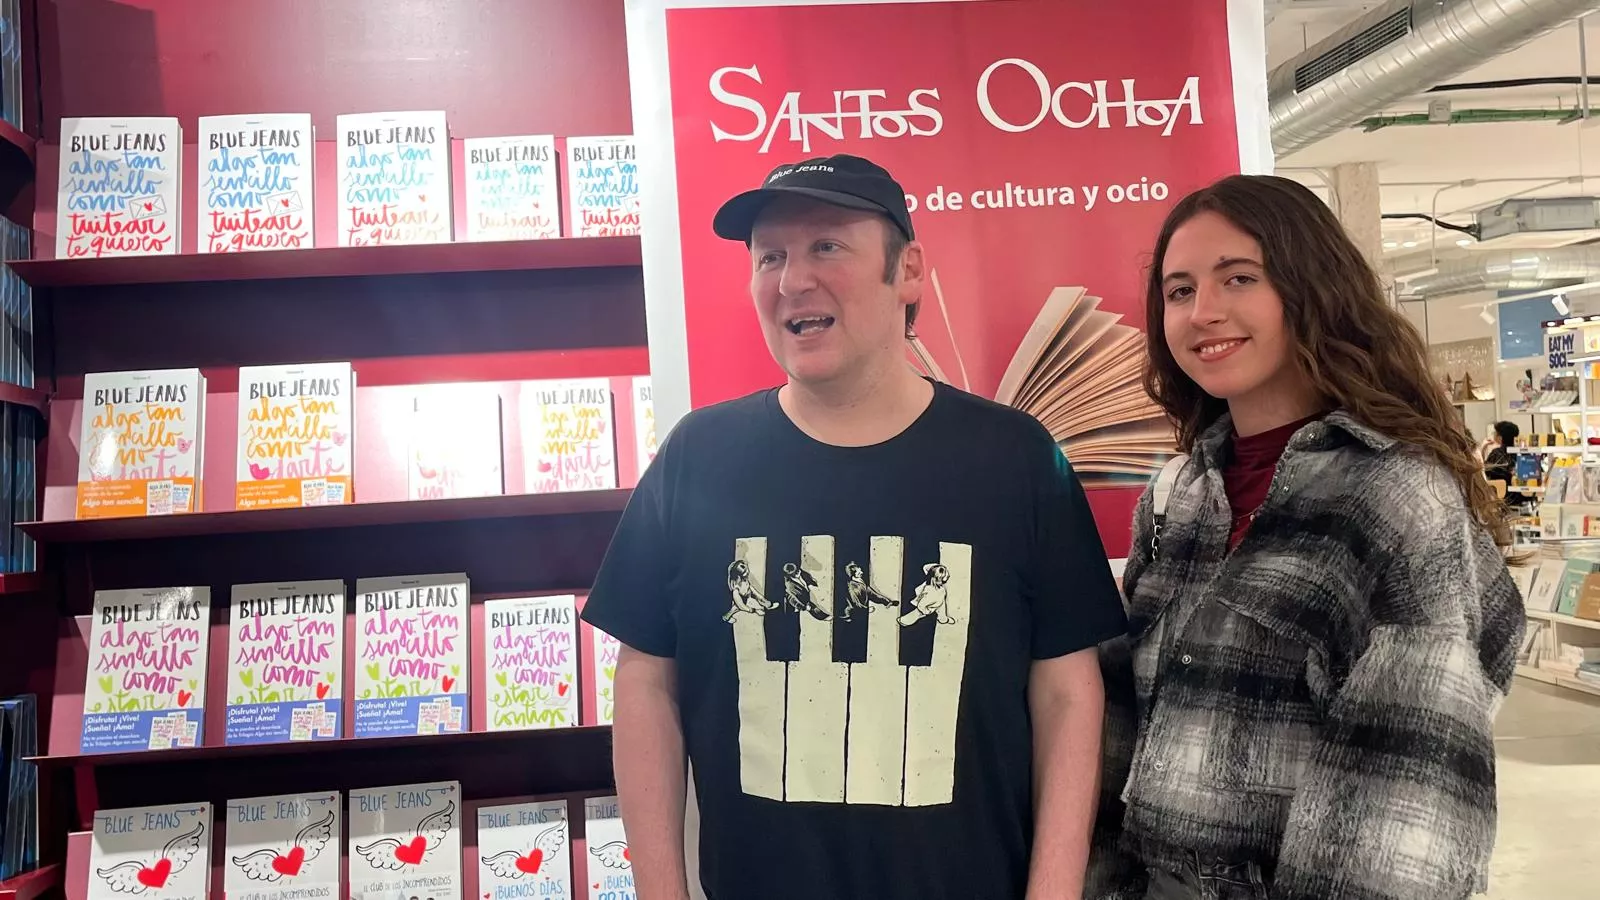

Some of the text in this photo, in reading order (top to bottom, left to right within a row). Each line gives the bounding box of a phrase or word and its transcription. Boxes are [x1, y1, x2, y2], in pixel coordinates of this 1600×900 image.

[71, 133, 167, 152] BLUE JEANS
[210, 130, 301, 150] BLUE JEANS
[348, 126, 435, 147] BLUE JEANS
[397, 144, 432, 161] tan
[471, 145, 549, 164] BLUE JEANS
[574, 145, 636, 162] BLUE JEA
[69, 149, 165, 184] algo tan
[208, 147, 300, 182] algo tan
[795, 165, 834, 173] Jeans
[68, 193, 134, 211] como
[208, 191, 271, 208] como
[925, 185, 962, 211] de
[970, 182, 1075, 209] cultura
[1081, 185, 1099, 211] y
[1106, 176, 1169, 203] ocio
[67, 212, 165, 236] tuitear
[208, 209, 302, 233] tuitear
[66, 235, 89, 257] te
[207, 232, 230, 252] te
[1549, 334, 1574, 352] EAT MY
[95, 384, 188, 406] BLUE JEANS
[250, 378, 340, 399] BLUE JEANS
[562, 388, 605, 405] JEANS
[92, 403, 185, 436] algo tan
[248, 396, 338, 432] algo tan
[247, 439, 311, 458] como
[240, 593, 335, 619] BLUE JEANS
[365, 587, 458, 613] BLUE JEANS
[102, 604, 141, 625] BLUE
[417, 608, 458, 631] tan
[492, 607, 570, 628] BLUE JEANS
[157, 622, 199, 644] tan
[293, 615, 334, 638] tan
[536, 627, 570, 646] tan
[262, 663, 320, 687] como
[389, 657, 446, 680] como
[514, 667, 560, 686] como
[123, 670, 183, 694] como
[238, 800, 311, 822] BLUE JEANS
[360, 789, 432, 812] BLUE JEANS
[488, 809, 548, 828] BLUE JEANS
[596, 804, 618, 819] BLUE
[105, 811, 180, 834] BLUE JEANS
[604, 875, 634, 890] ¡BUEN
